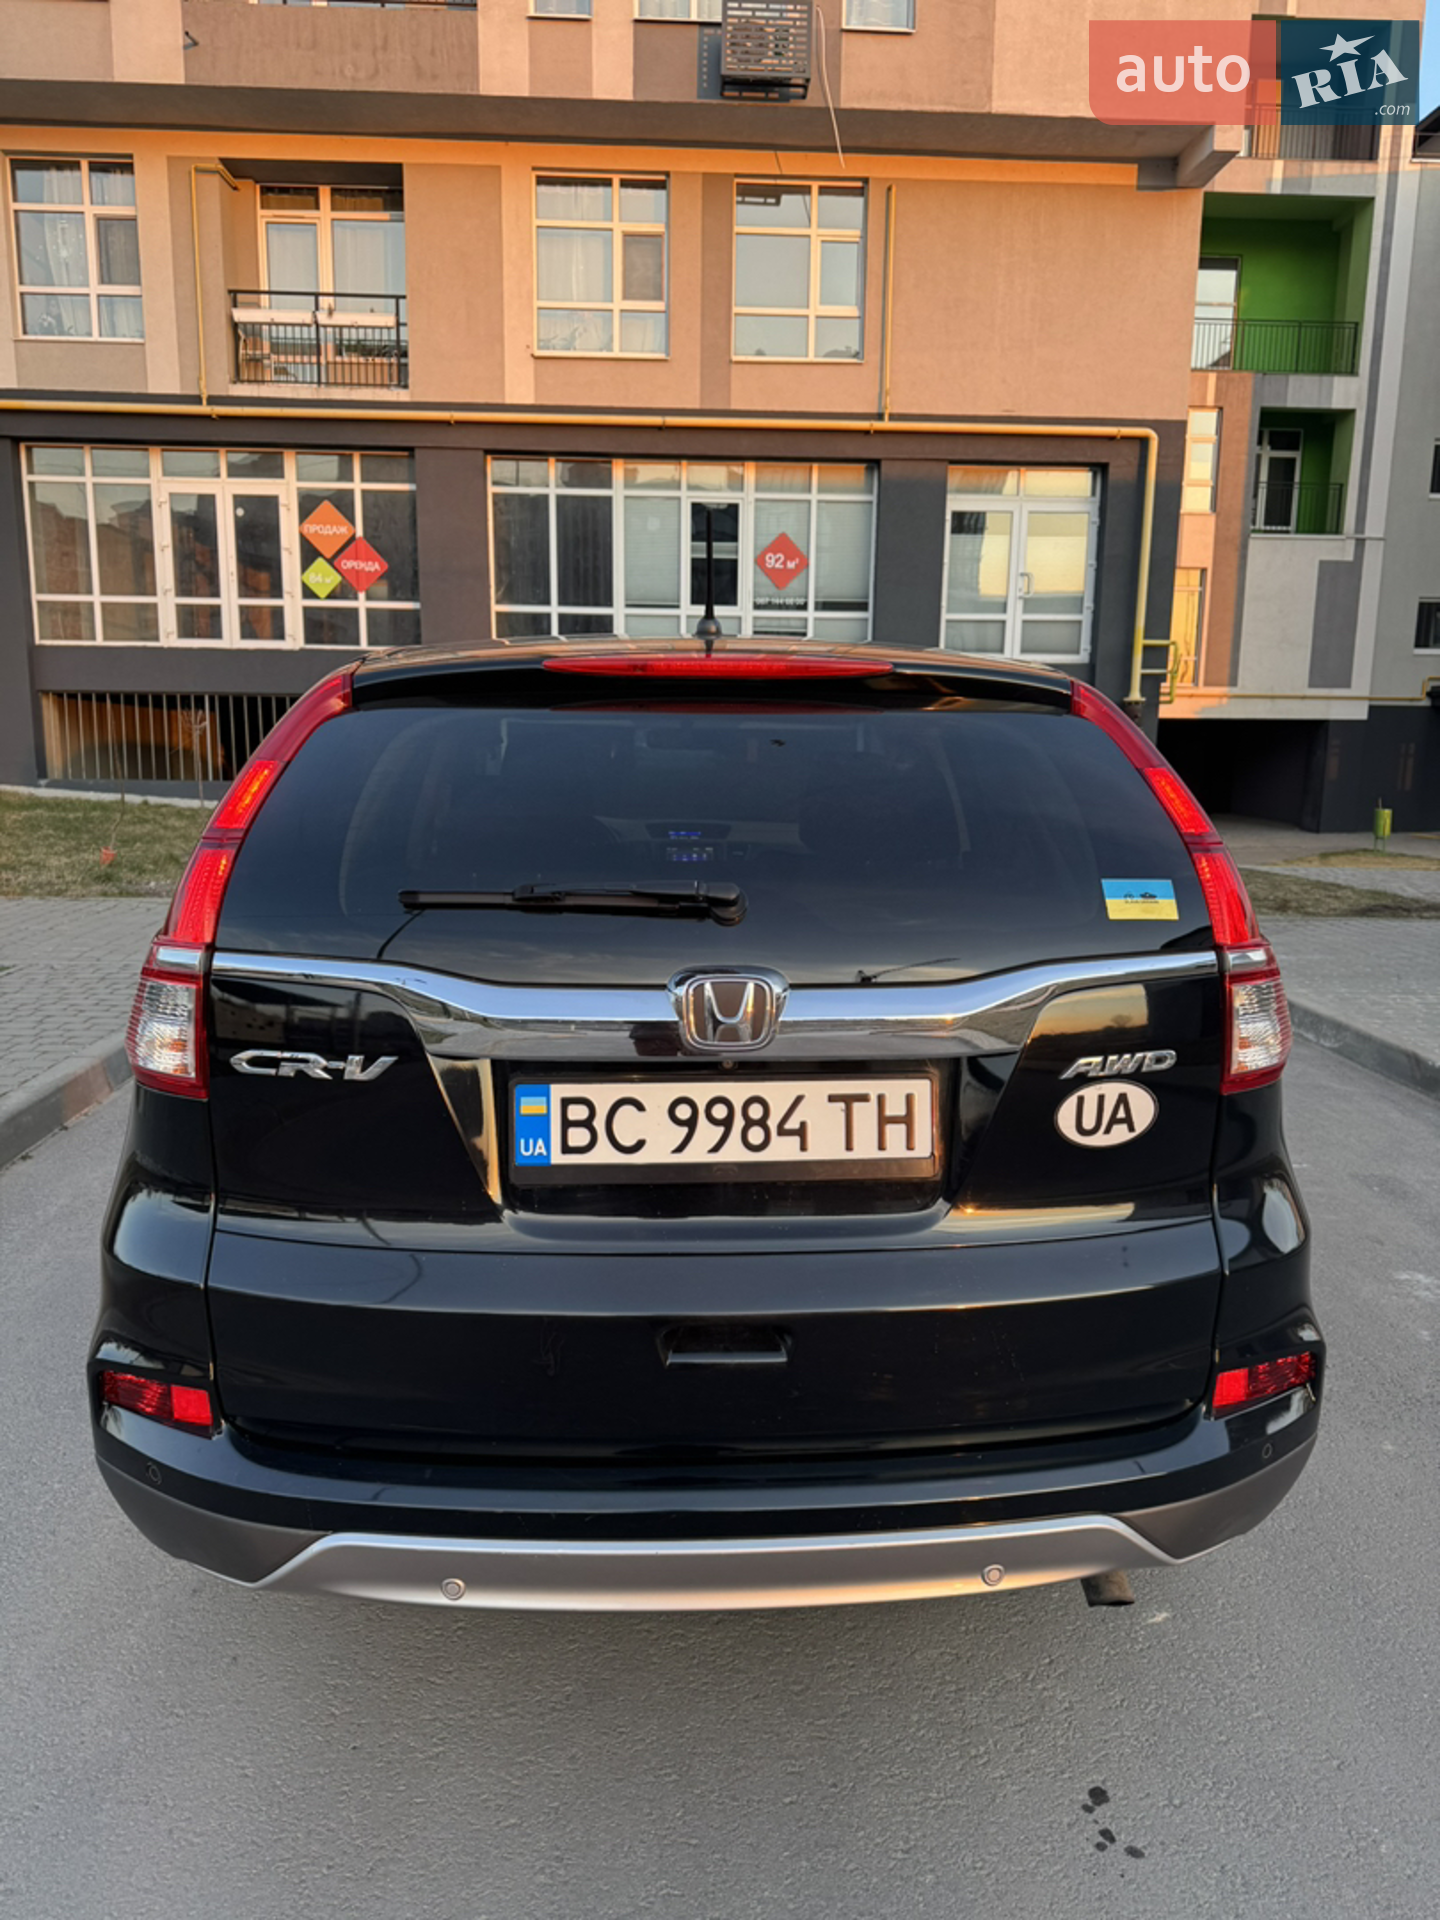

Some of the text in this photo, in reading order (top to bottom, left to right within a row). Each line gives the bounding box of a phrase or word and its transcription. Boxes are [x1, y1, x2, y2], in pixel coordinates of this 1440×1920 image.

[303, 524, 349, 536] ПРОДАЖ
[341, 560, 381, 572] ОРЕНДА
[765, 552, 785, 569] 92
[229, 1049, 399, 1081] CR-V
[1058, 1049, 1178, 1080] AWD
[559, 1093, 915, 1155] BC 9984 TH
[1075, 1092, 1136, 1137] UA
[520, 1138, 548, 1156] UA
